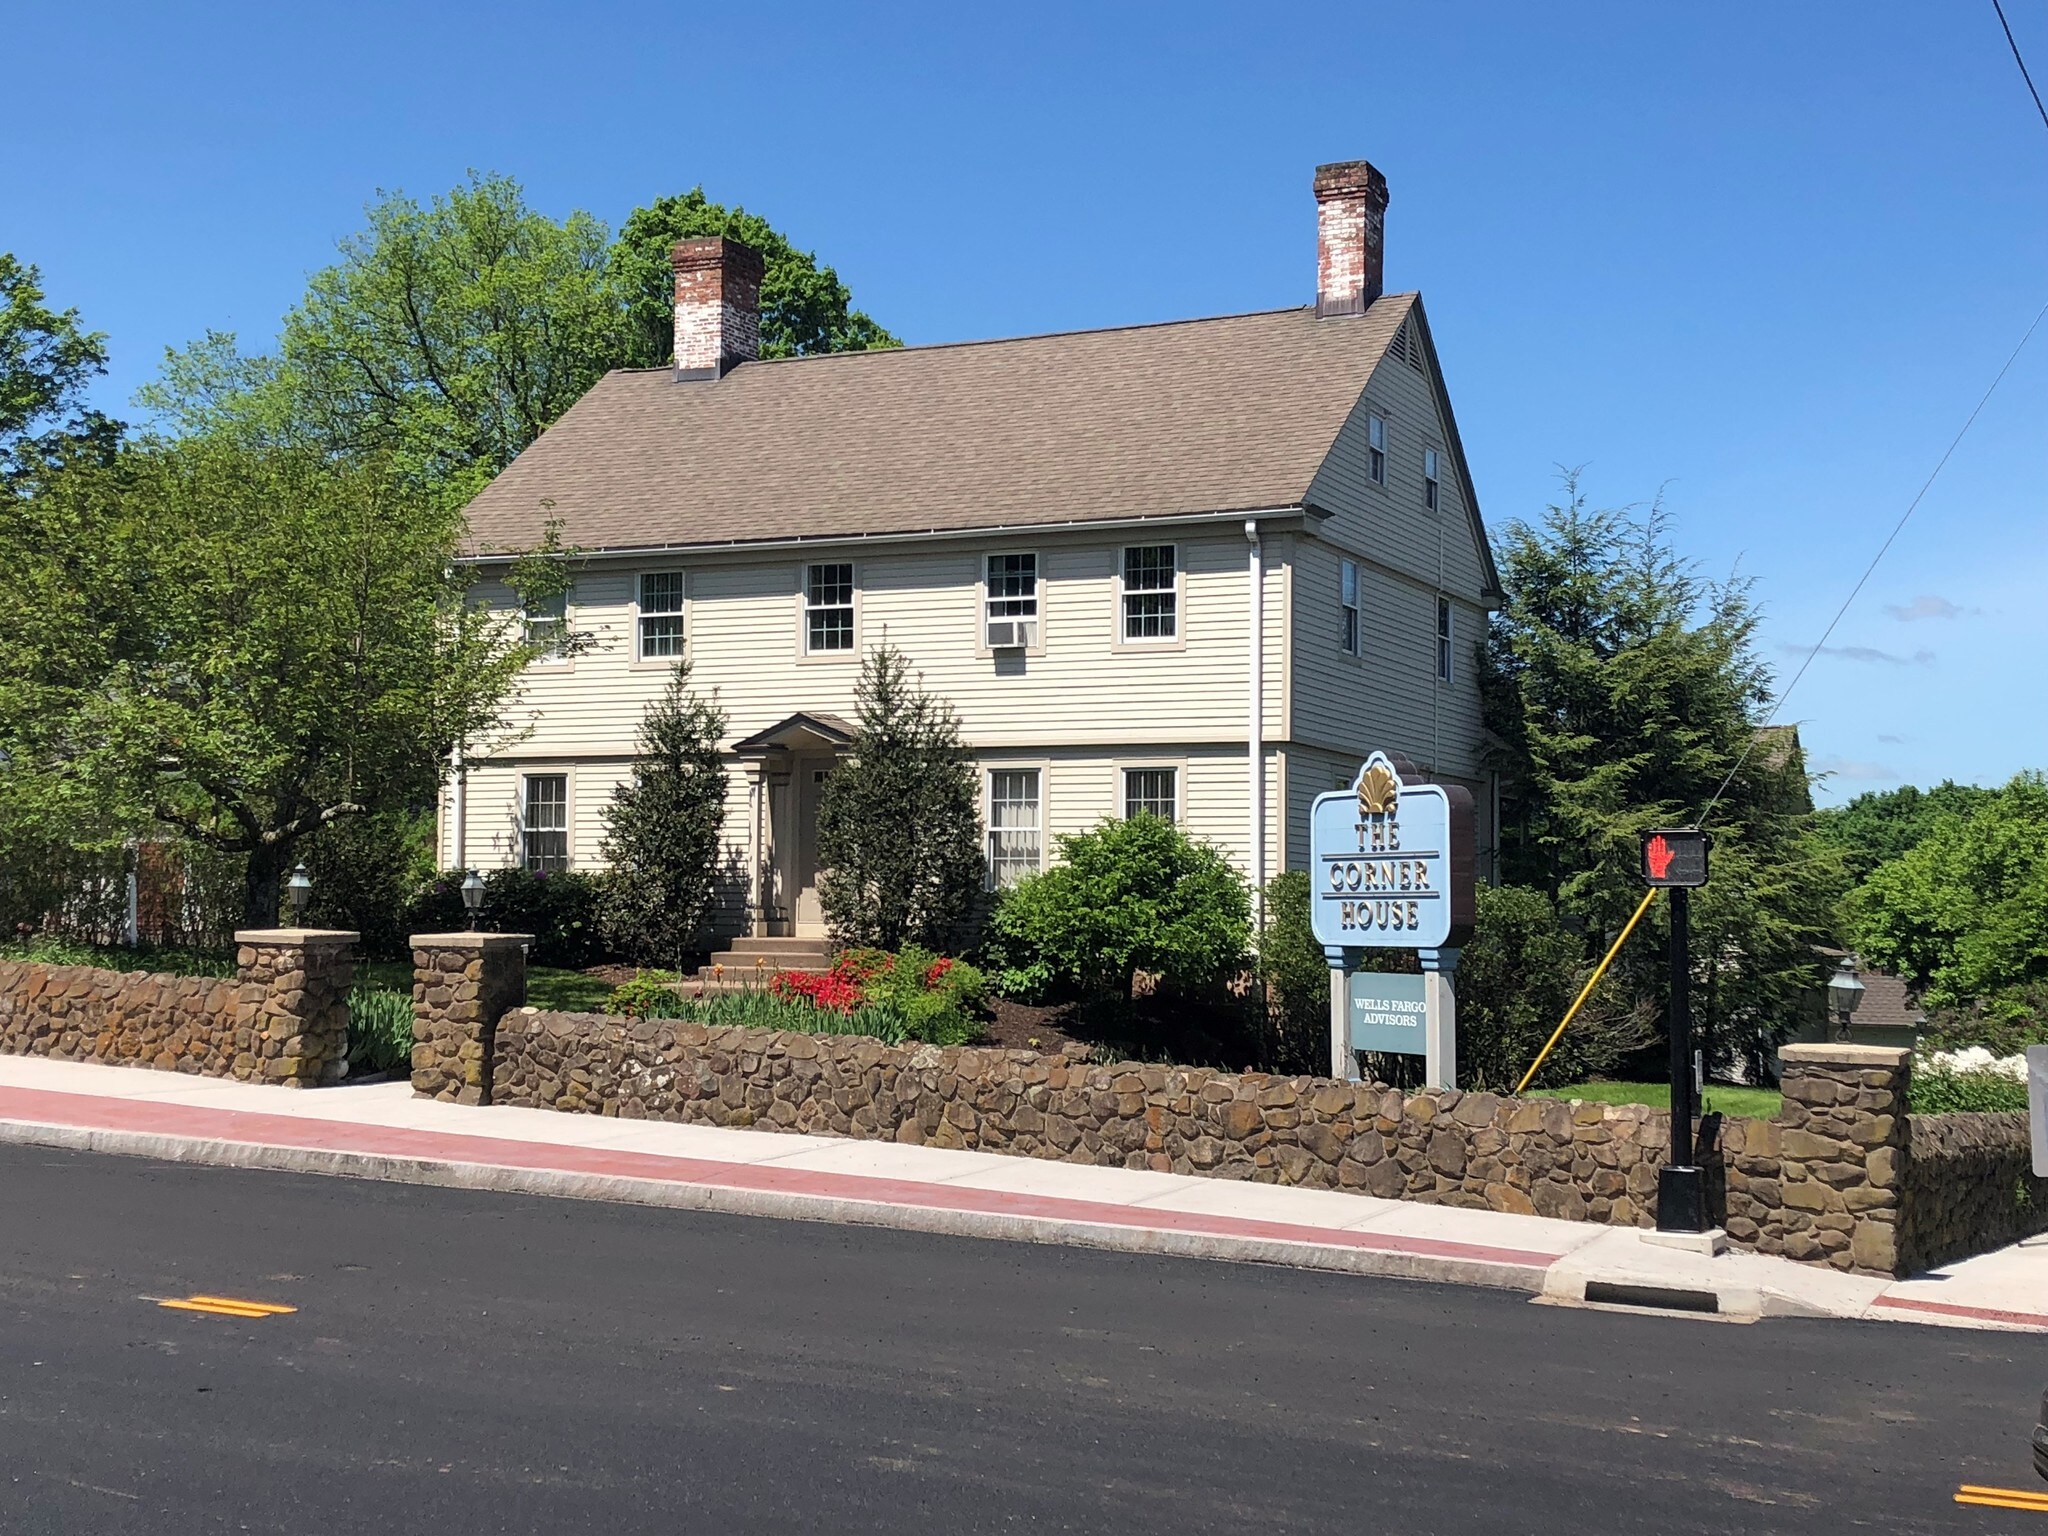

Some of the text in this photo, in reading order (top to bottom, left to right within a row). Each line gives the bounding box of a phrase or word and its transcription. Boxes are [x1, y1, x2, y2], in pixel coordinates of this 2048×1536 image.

[1354, 822, 1399, 851] THE
[1330, 861, 1429, 890] CORNER
[1341, 901, 1418, 930] HOUSE
[1354, 998, 1426, 1013] WELLS FARGO
[1363, 1013, 1417, 1027] ADVISORS
